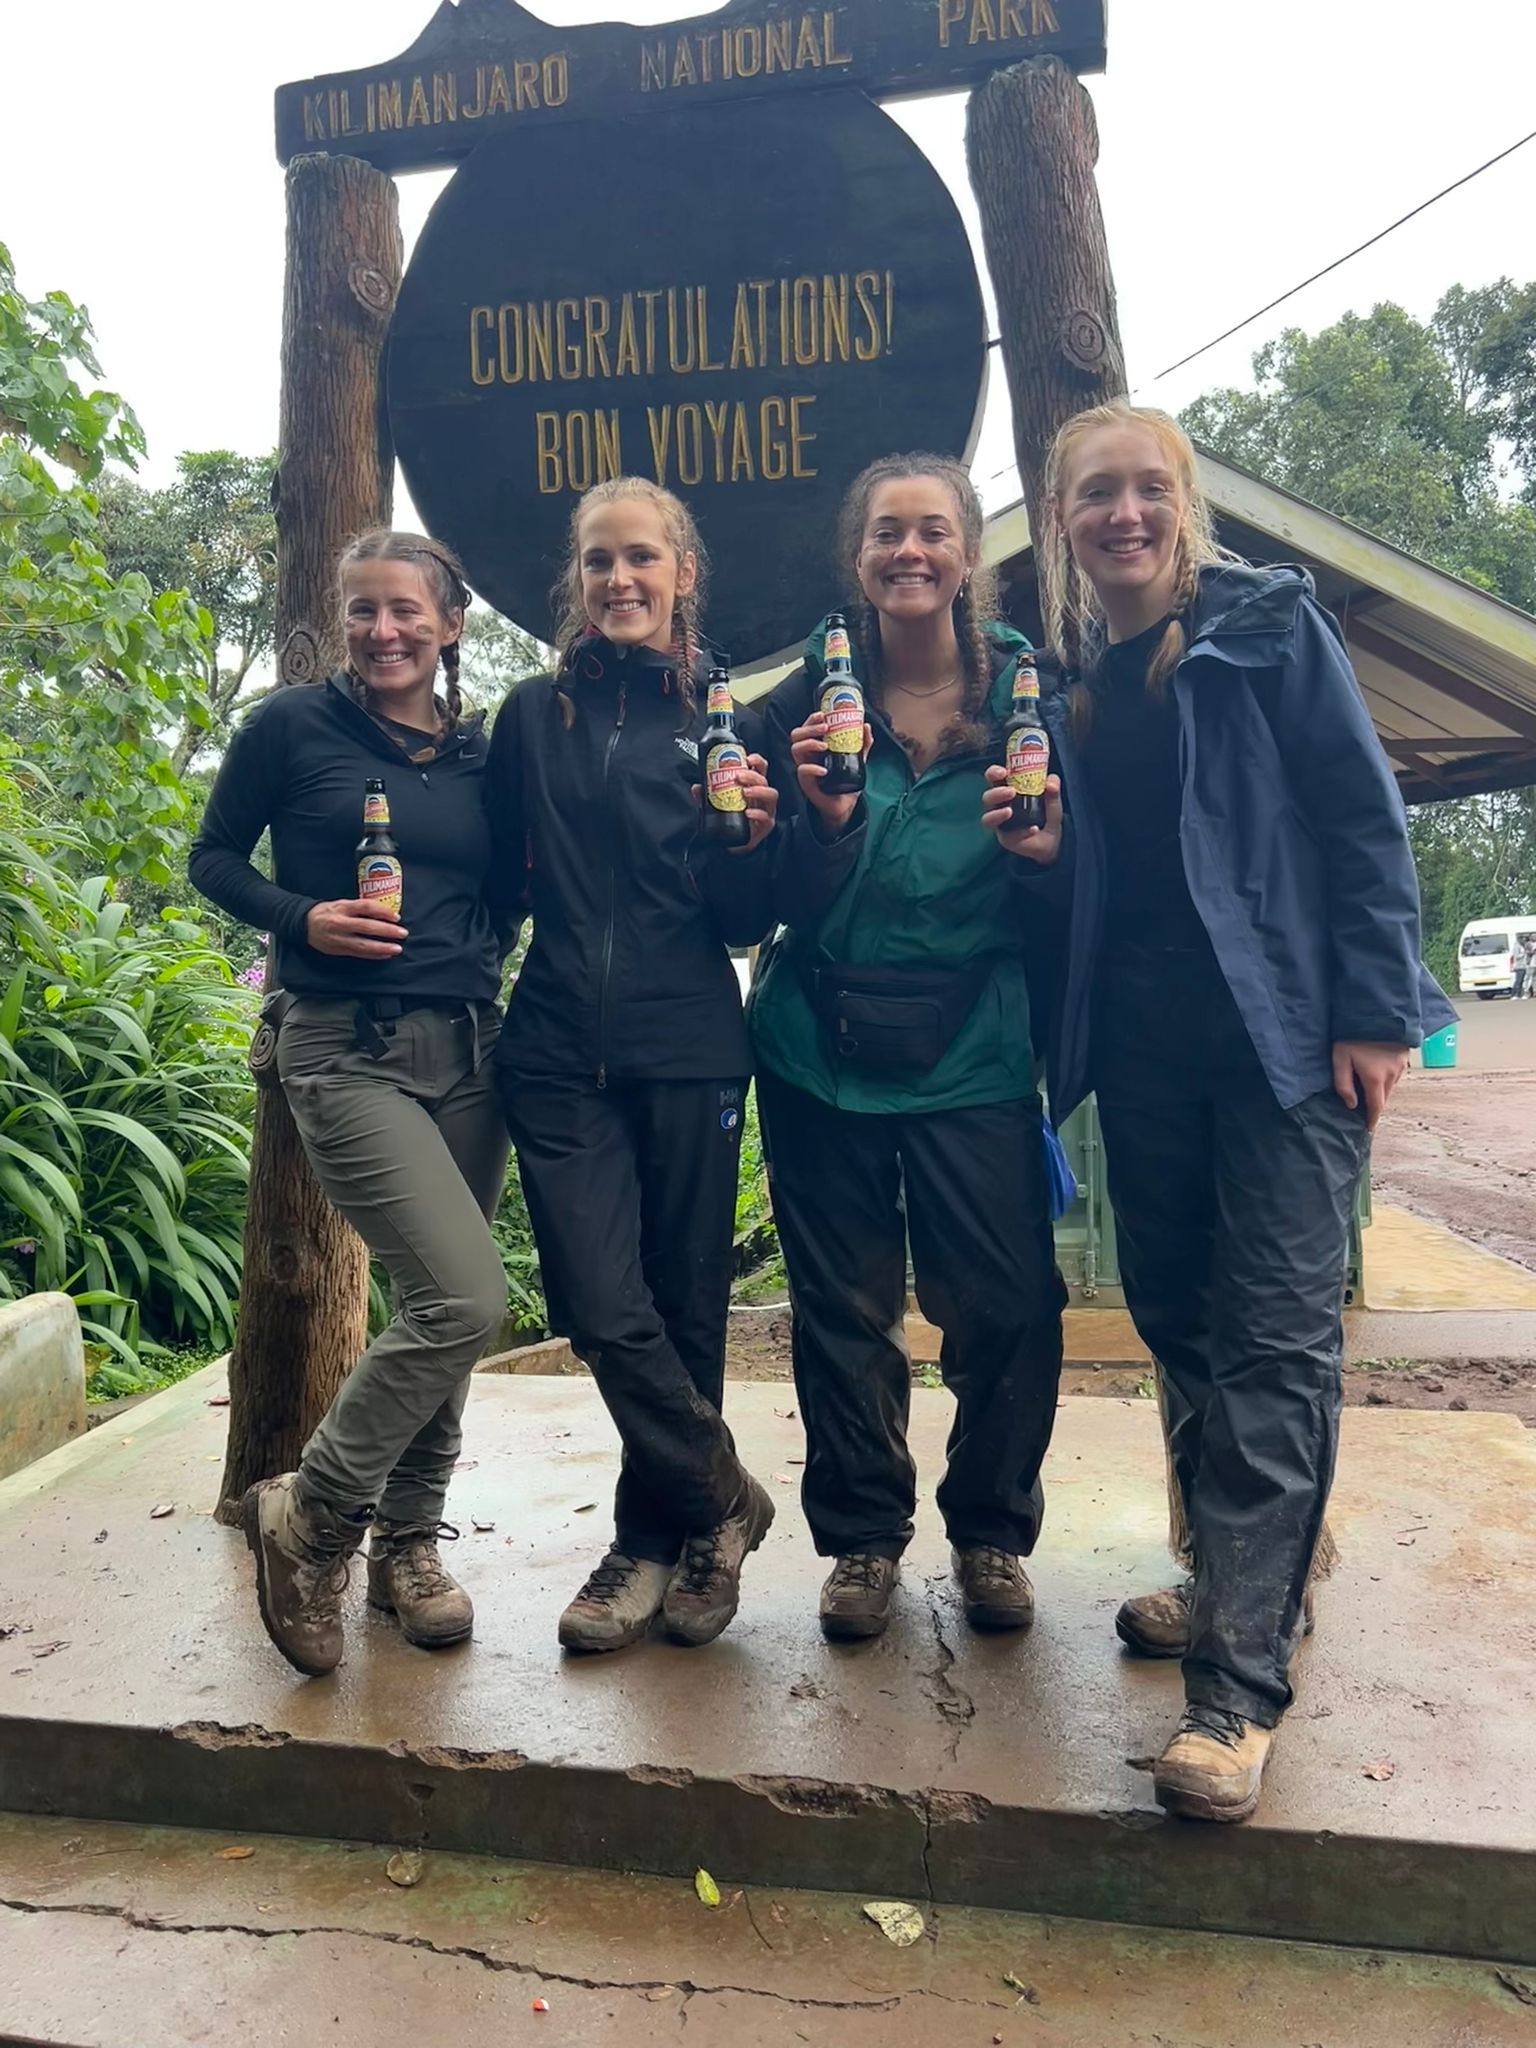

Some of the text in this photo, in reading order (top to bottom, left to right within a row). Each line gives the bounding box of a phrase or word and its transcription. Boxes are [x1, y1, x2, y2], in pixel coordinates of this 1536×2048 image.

[303, 0, 1060, 141] KILIMANJARO NATIONAL PARK
[469, 269, 895, 386] CONGRATULATIONS!
[535, 395, 819, 494] BON VOYAGE
